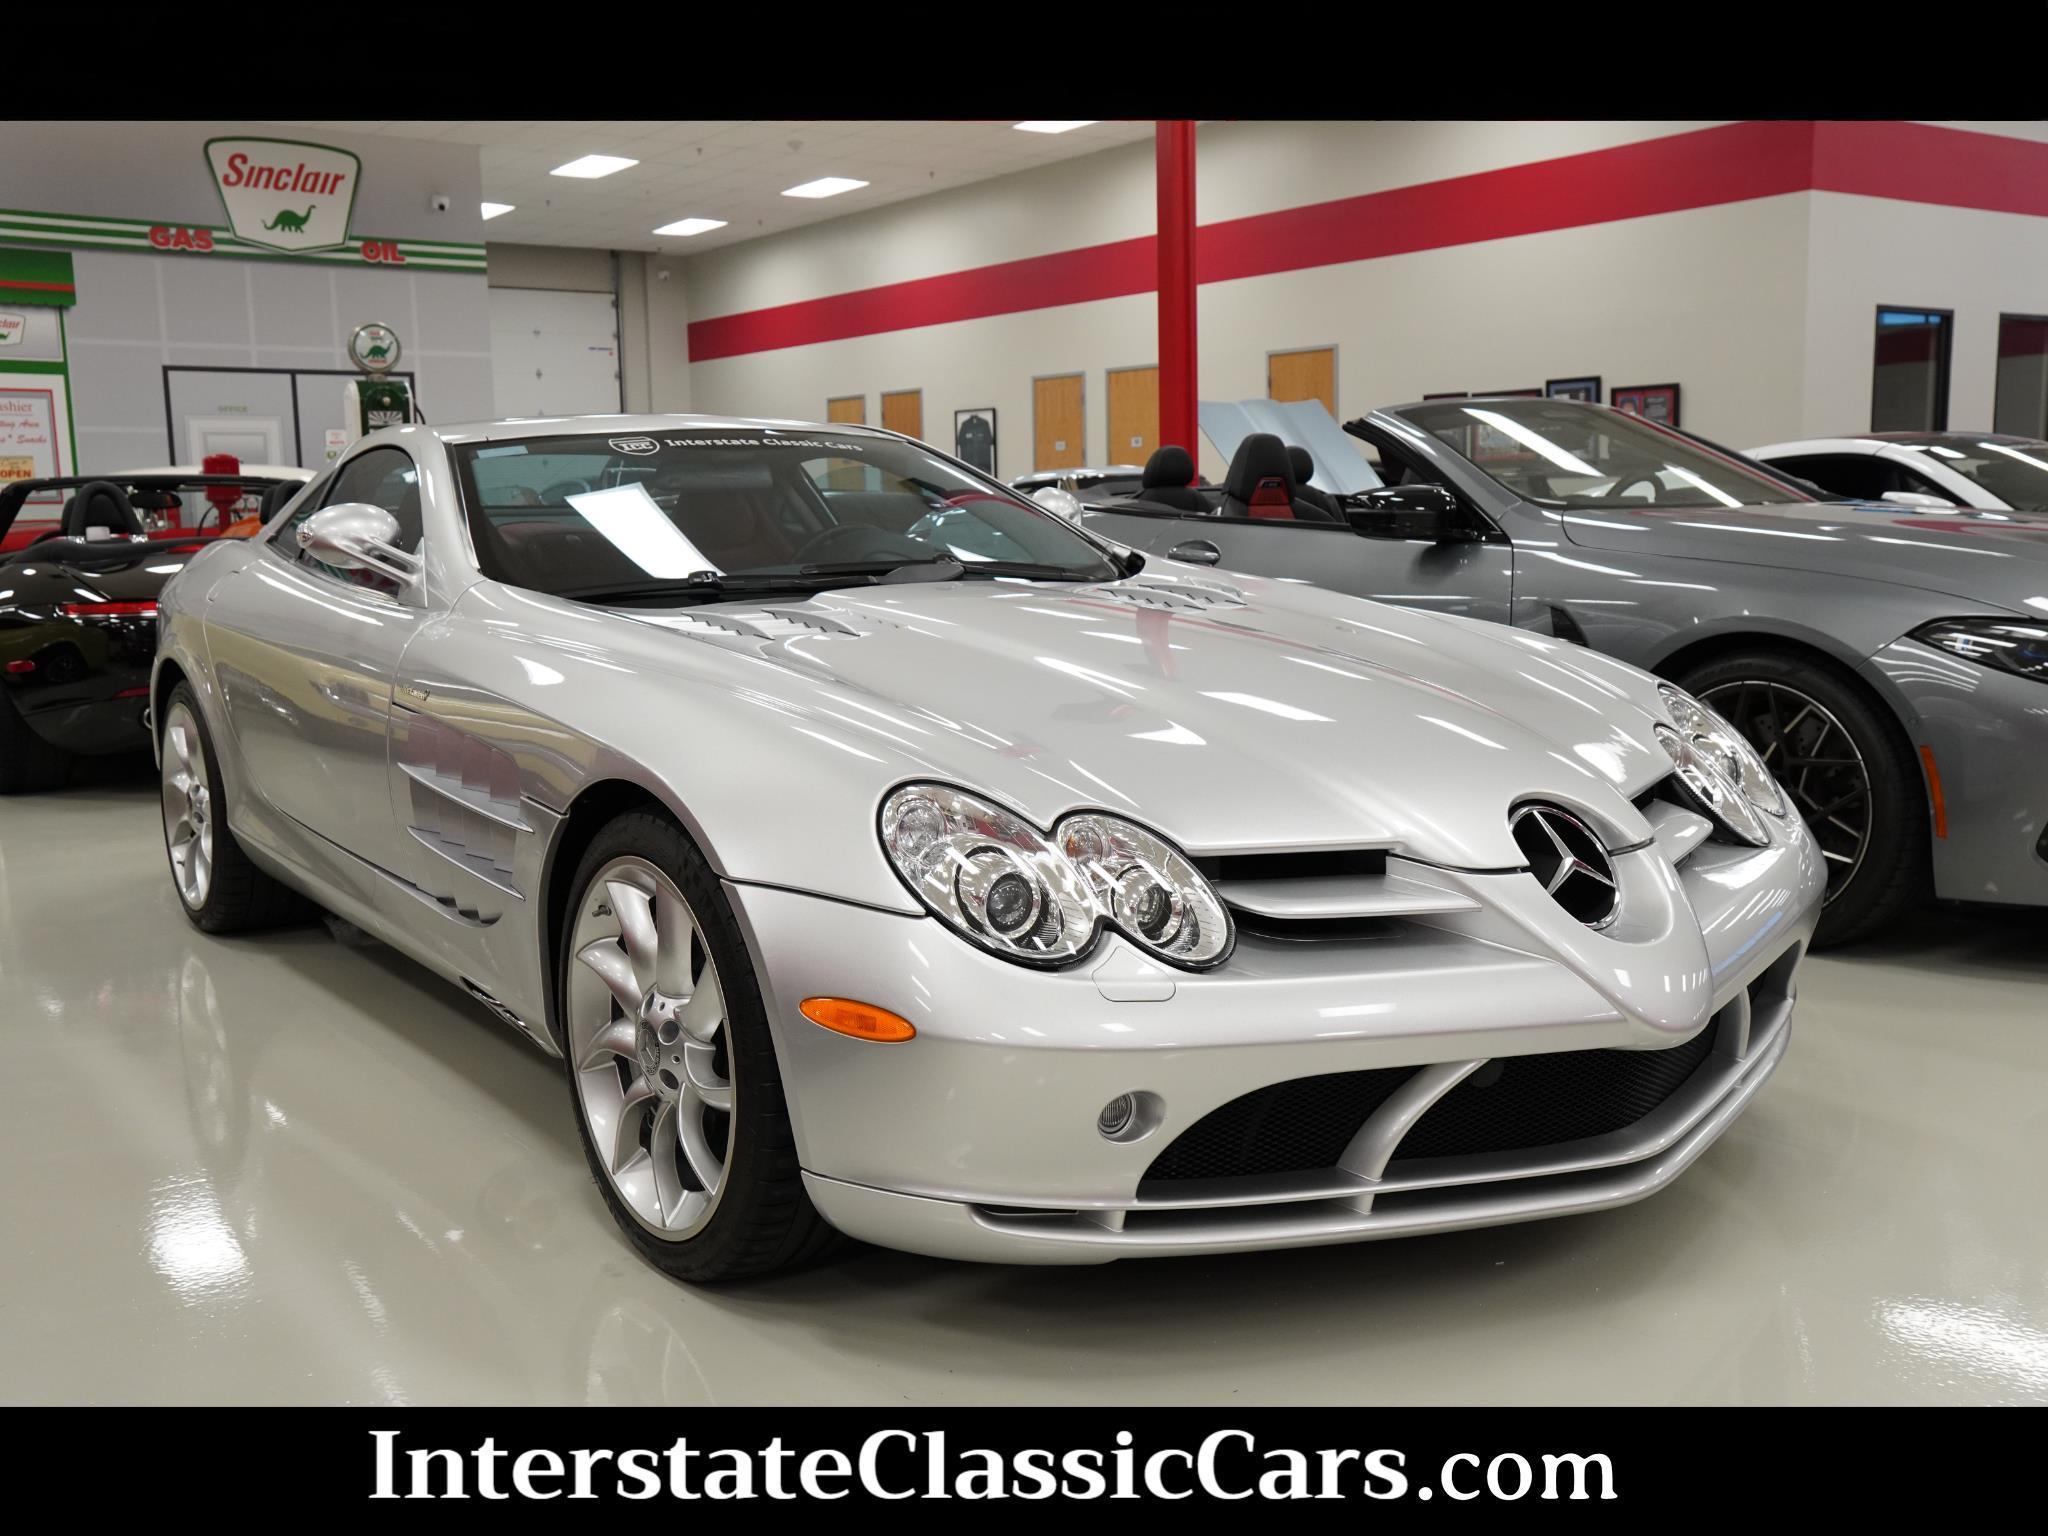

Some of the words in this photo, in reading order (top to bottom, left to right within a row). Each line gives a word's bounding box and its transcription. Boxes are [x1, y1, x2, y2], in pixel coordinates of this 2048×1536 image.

[222, 152, 346, 196] Sinclair
[149, 226, 214, 251] GAS
[361, 240, 406, 264] OIL
[618, 441, 654, 452] ICC
[664, 438, 760, 448] Interstate
[762, 438, 823, 448] Classic
[824, 441, 863, 452] Cars
[0, 469, 32, 478] OPEN
